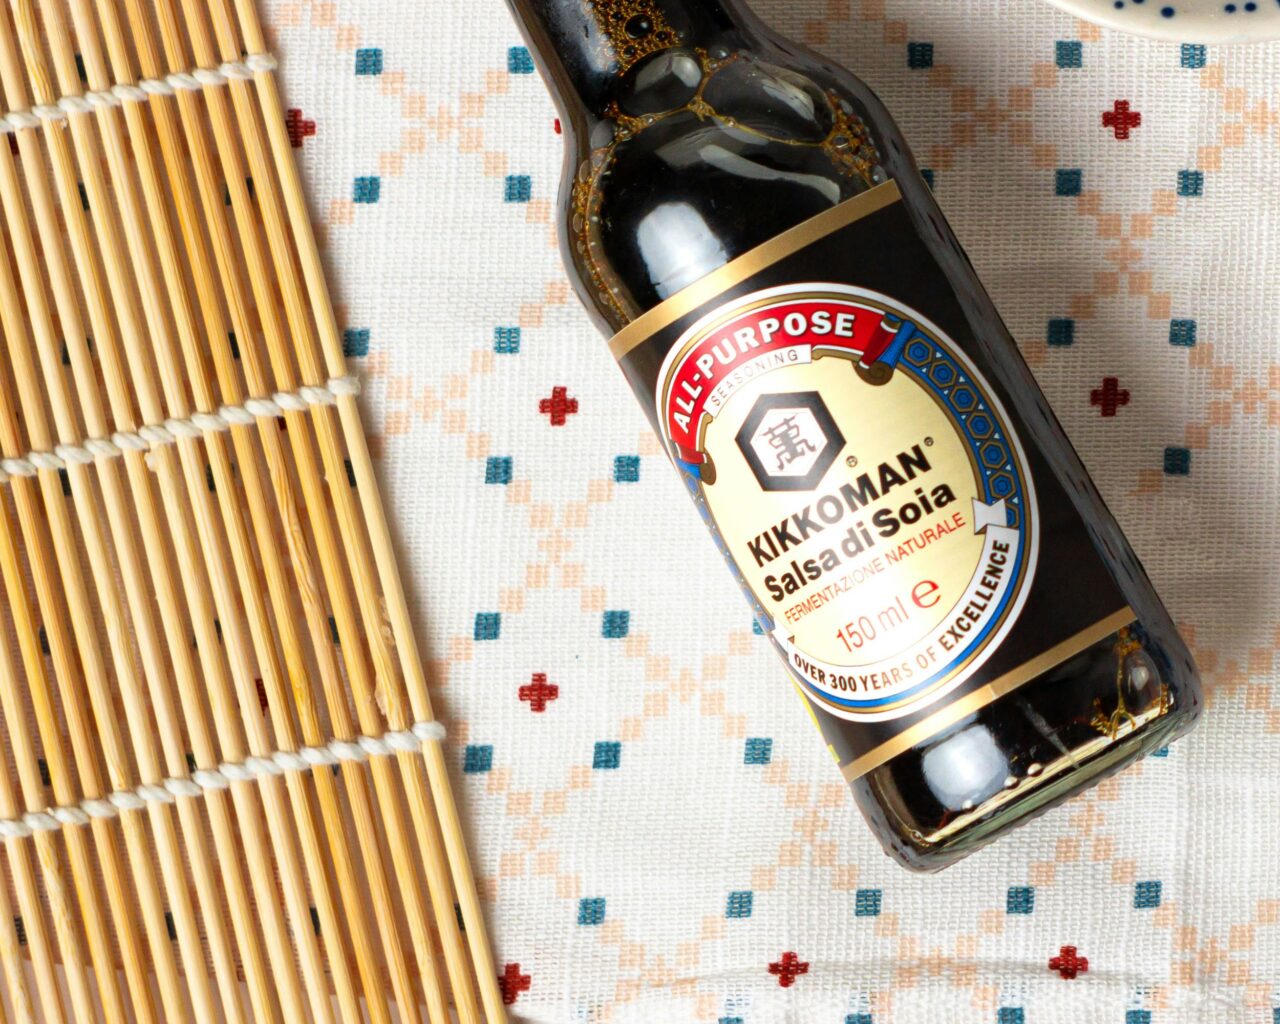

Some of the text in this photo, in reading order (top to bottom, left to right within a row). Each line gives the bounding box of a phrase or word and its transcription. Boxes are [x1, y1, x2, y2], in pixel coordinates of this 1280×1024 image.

[673, 310, 856, 434] ALL-PURPOSE
[711, 349, 799, 407] SEASONING
[764, 483, 957, 602] Salsa di Soia
[784, 512, 966, 624] FERMENTAZIONE NATURALE
[794, 540, 1010, 692] OVER 300 YEARS OF EXCELLENCE
[836, 615, 877, 653] 150
[877, 596, 910, 631] ml
